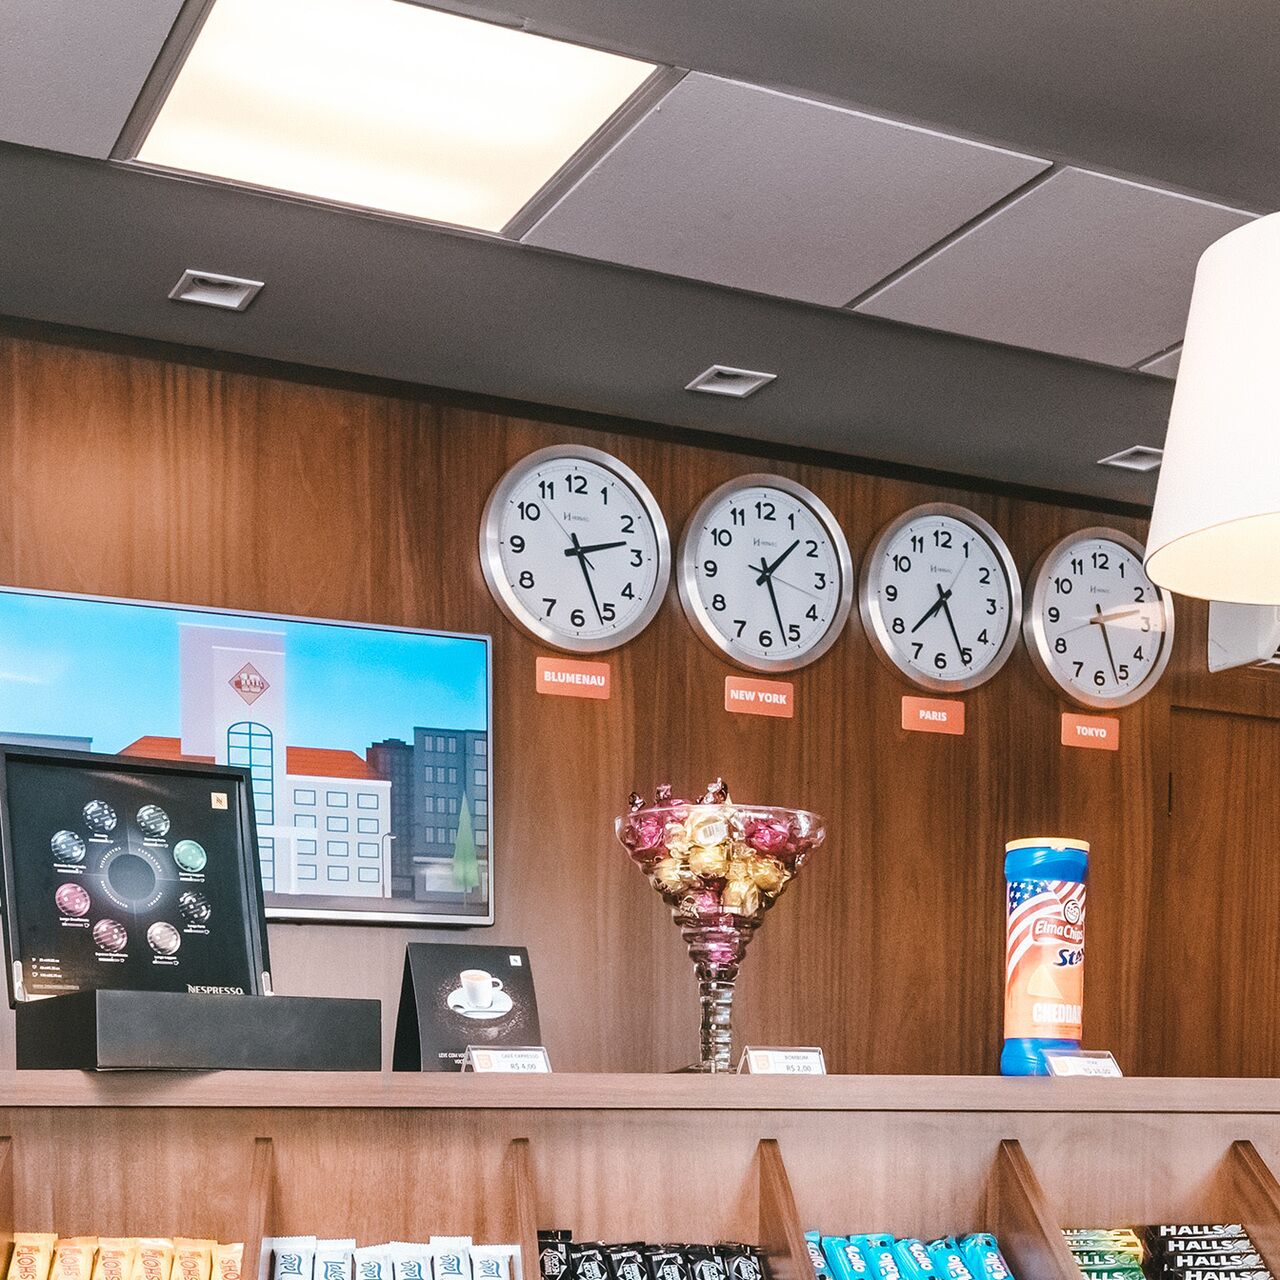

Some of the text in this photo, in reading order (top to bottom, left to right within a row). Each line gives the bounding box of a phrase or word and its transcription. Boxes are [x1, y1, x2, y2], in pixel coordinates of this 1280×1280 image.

[538, 481, 554, 500] 11
[565, 474, 588, 494] 12
[600, 487, 608, 504] 1
[517, 501, 540, 521] 10
[730, 508, 745, 526] 11
[755, 501, 777, 521] 12
[621, 515, 634, 533] 2
[788, 513, 795, 530] 1
[510, 535, 525, 553] 9
[710, 528, 732, 547] 10
[805, 540, 819, 557] 2
[630, 549, 643, 567] 3
[703, 560, 717, 577] 9
[519, 571, 534, 588] 8
[814, 572, 826, 590] 3
[621, 582, 634, 599] 4
[542, 598, 557, 617] 7
[712, 594, 726, 611] 8
[570, 609, 585, 627] 6
[603, 603, 616, 621] 5
[805, 604, 818, 621] 4
[733, 620, 747, 638] 7
[788, 625, 800, 642] 5
[758, 630, 772, 647] 6
[544, 671, 605, 687] BLUMENAU
[730, 689, 787, 704] NEW YORK
[919, 709, 947, 722] PARIS
[1076, 725, 1107, 738] TOKYO
[1035, 920, 1063, 936] Elma
[186, 984, 244, 995] NESPRESSO
[1160, 1224, 1225, 1236] HALLS
[17, 1246, 40, 1280] SHOT
[1176, 1254, 1243, 1267] HALLS
